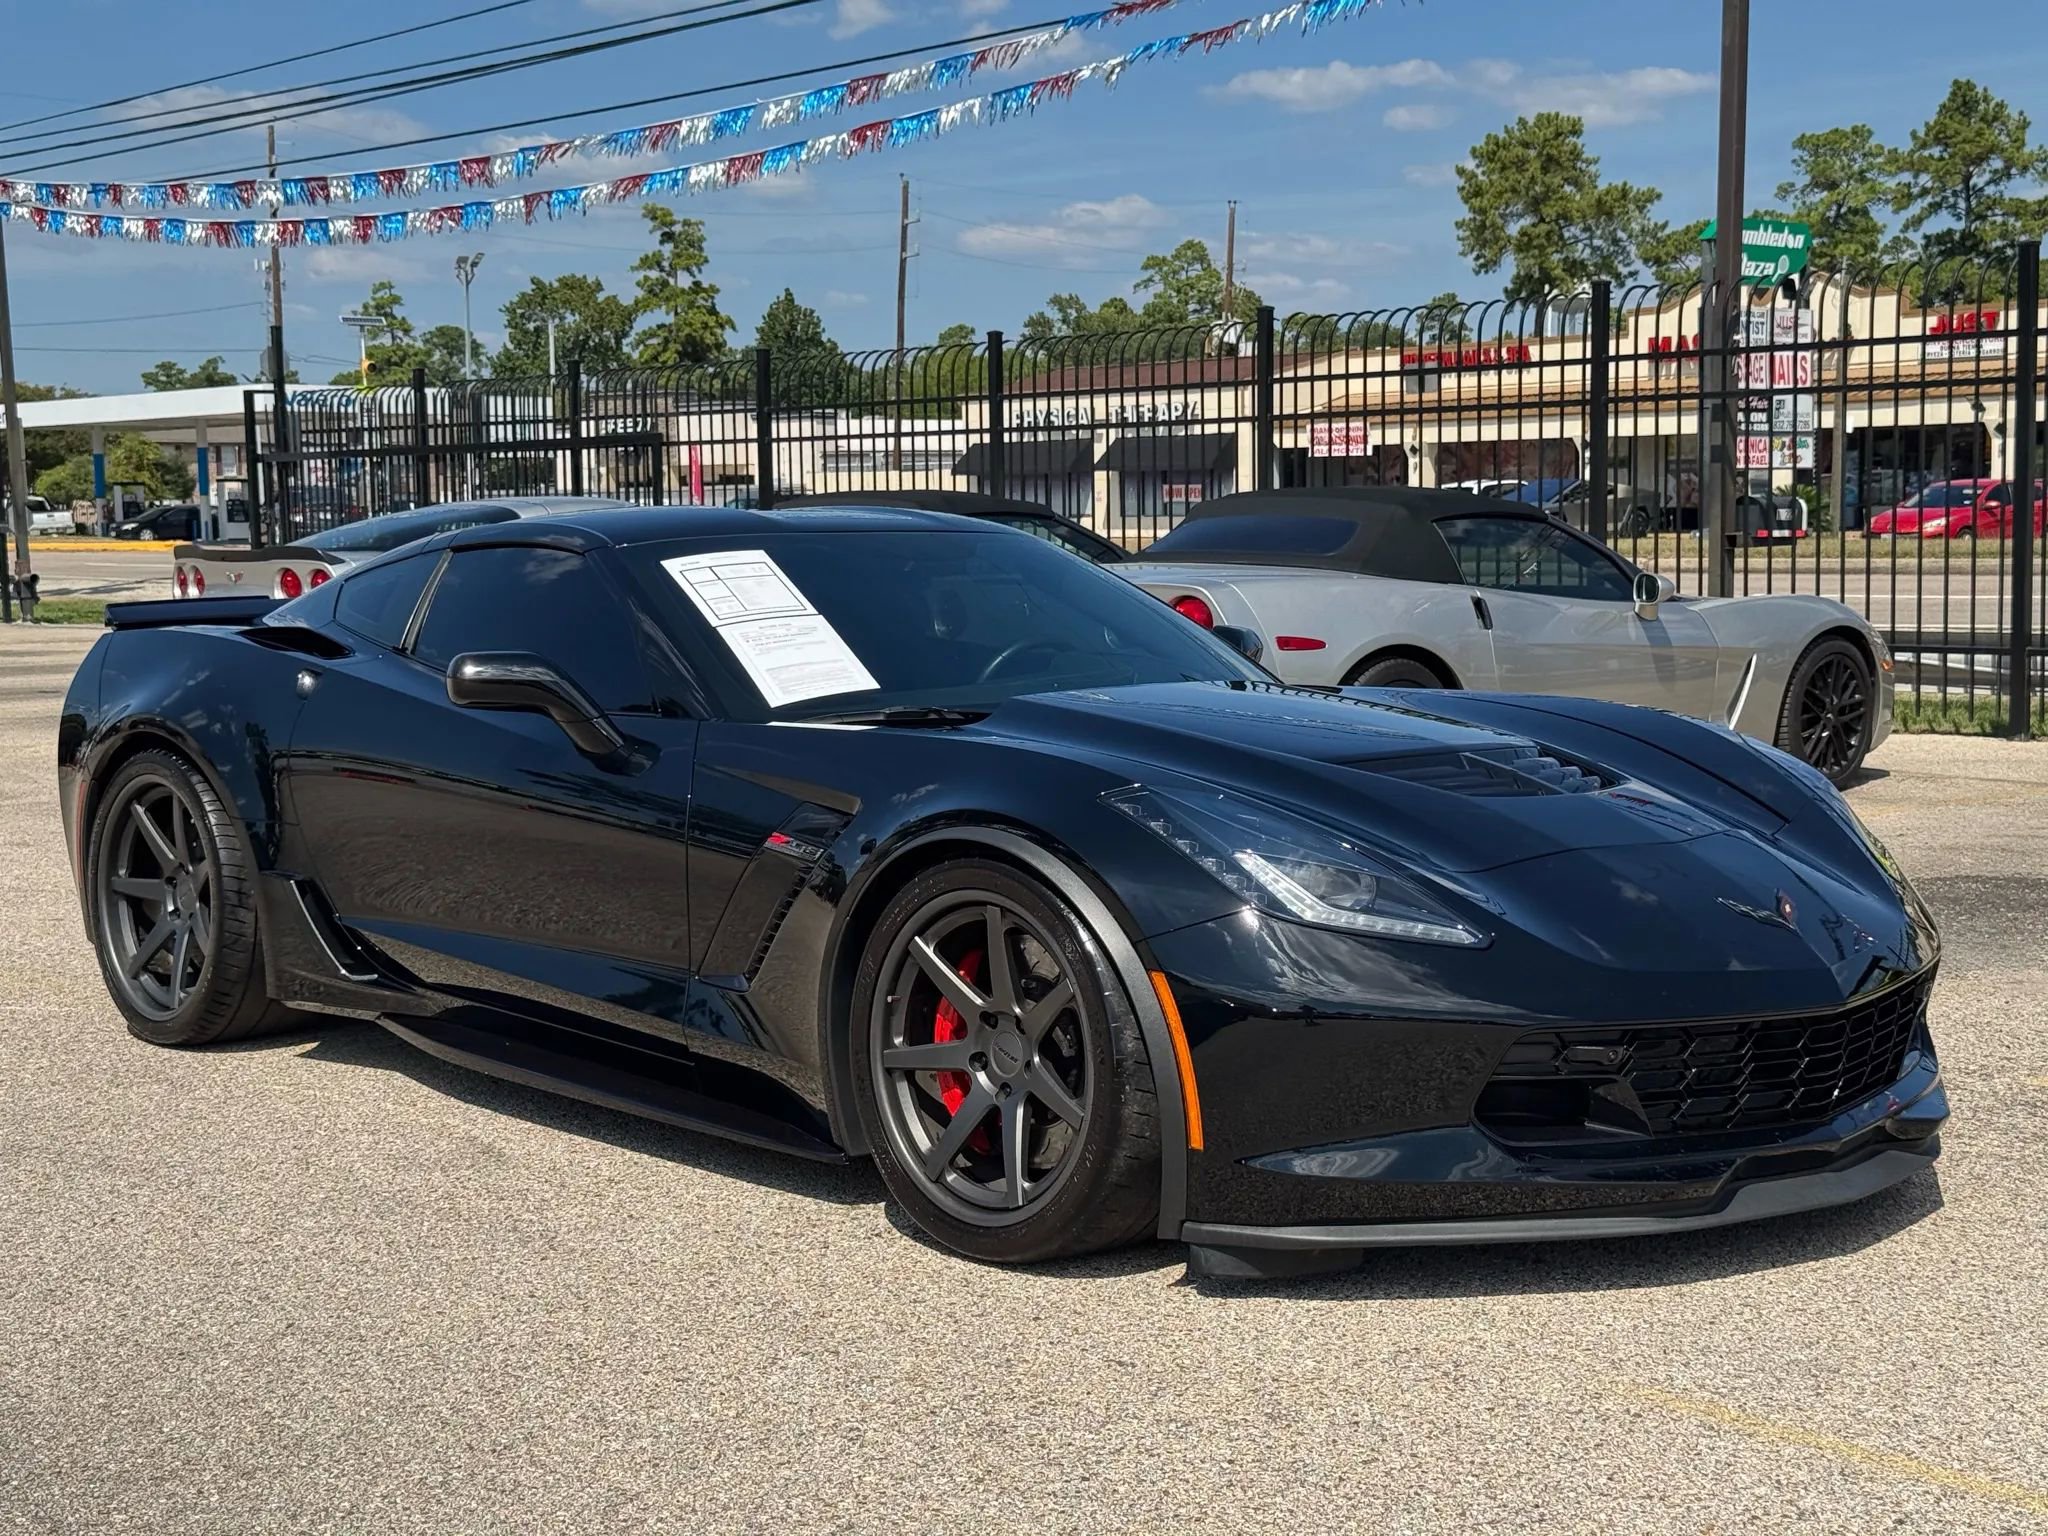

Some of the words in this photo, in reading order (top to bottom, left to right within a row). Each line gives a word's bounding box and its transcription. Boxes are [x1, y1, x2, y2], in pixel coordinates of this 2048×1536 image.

[1742, 223, 1805, 249] mbledon
[1741, 252, 1776, 277] laza
[1776, 315, 1799, 330] JUS
[1929, 311, 1999, 335] JUST
[1964, 343, 1984, 351] TIENA
[1772, 354, 1808, 385] AIS
[1014, 407, 1094, 428] PHYSICA
[1737, 412, 1767, 422] AON
[1738, 439, 1767, 454] CNICA
[1747, 455, 1767, 466] FAEL
[1186, 487, 1202, 498] PEN
